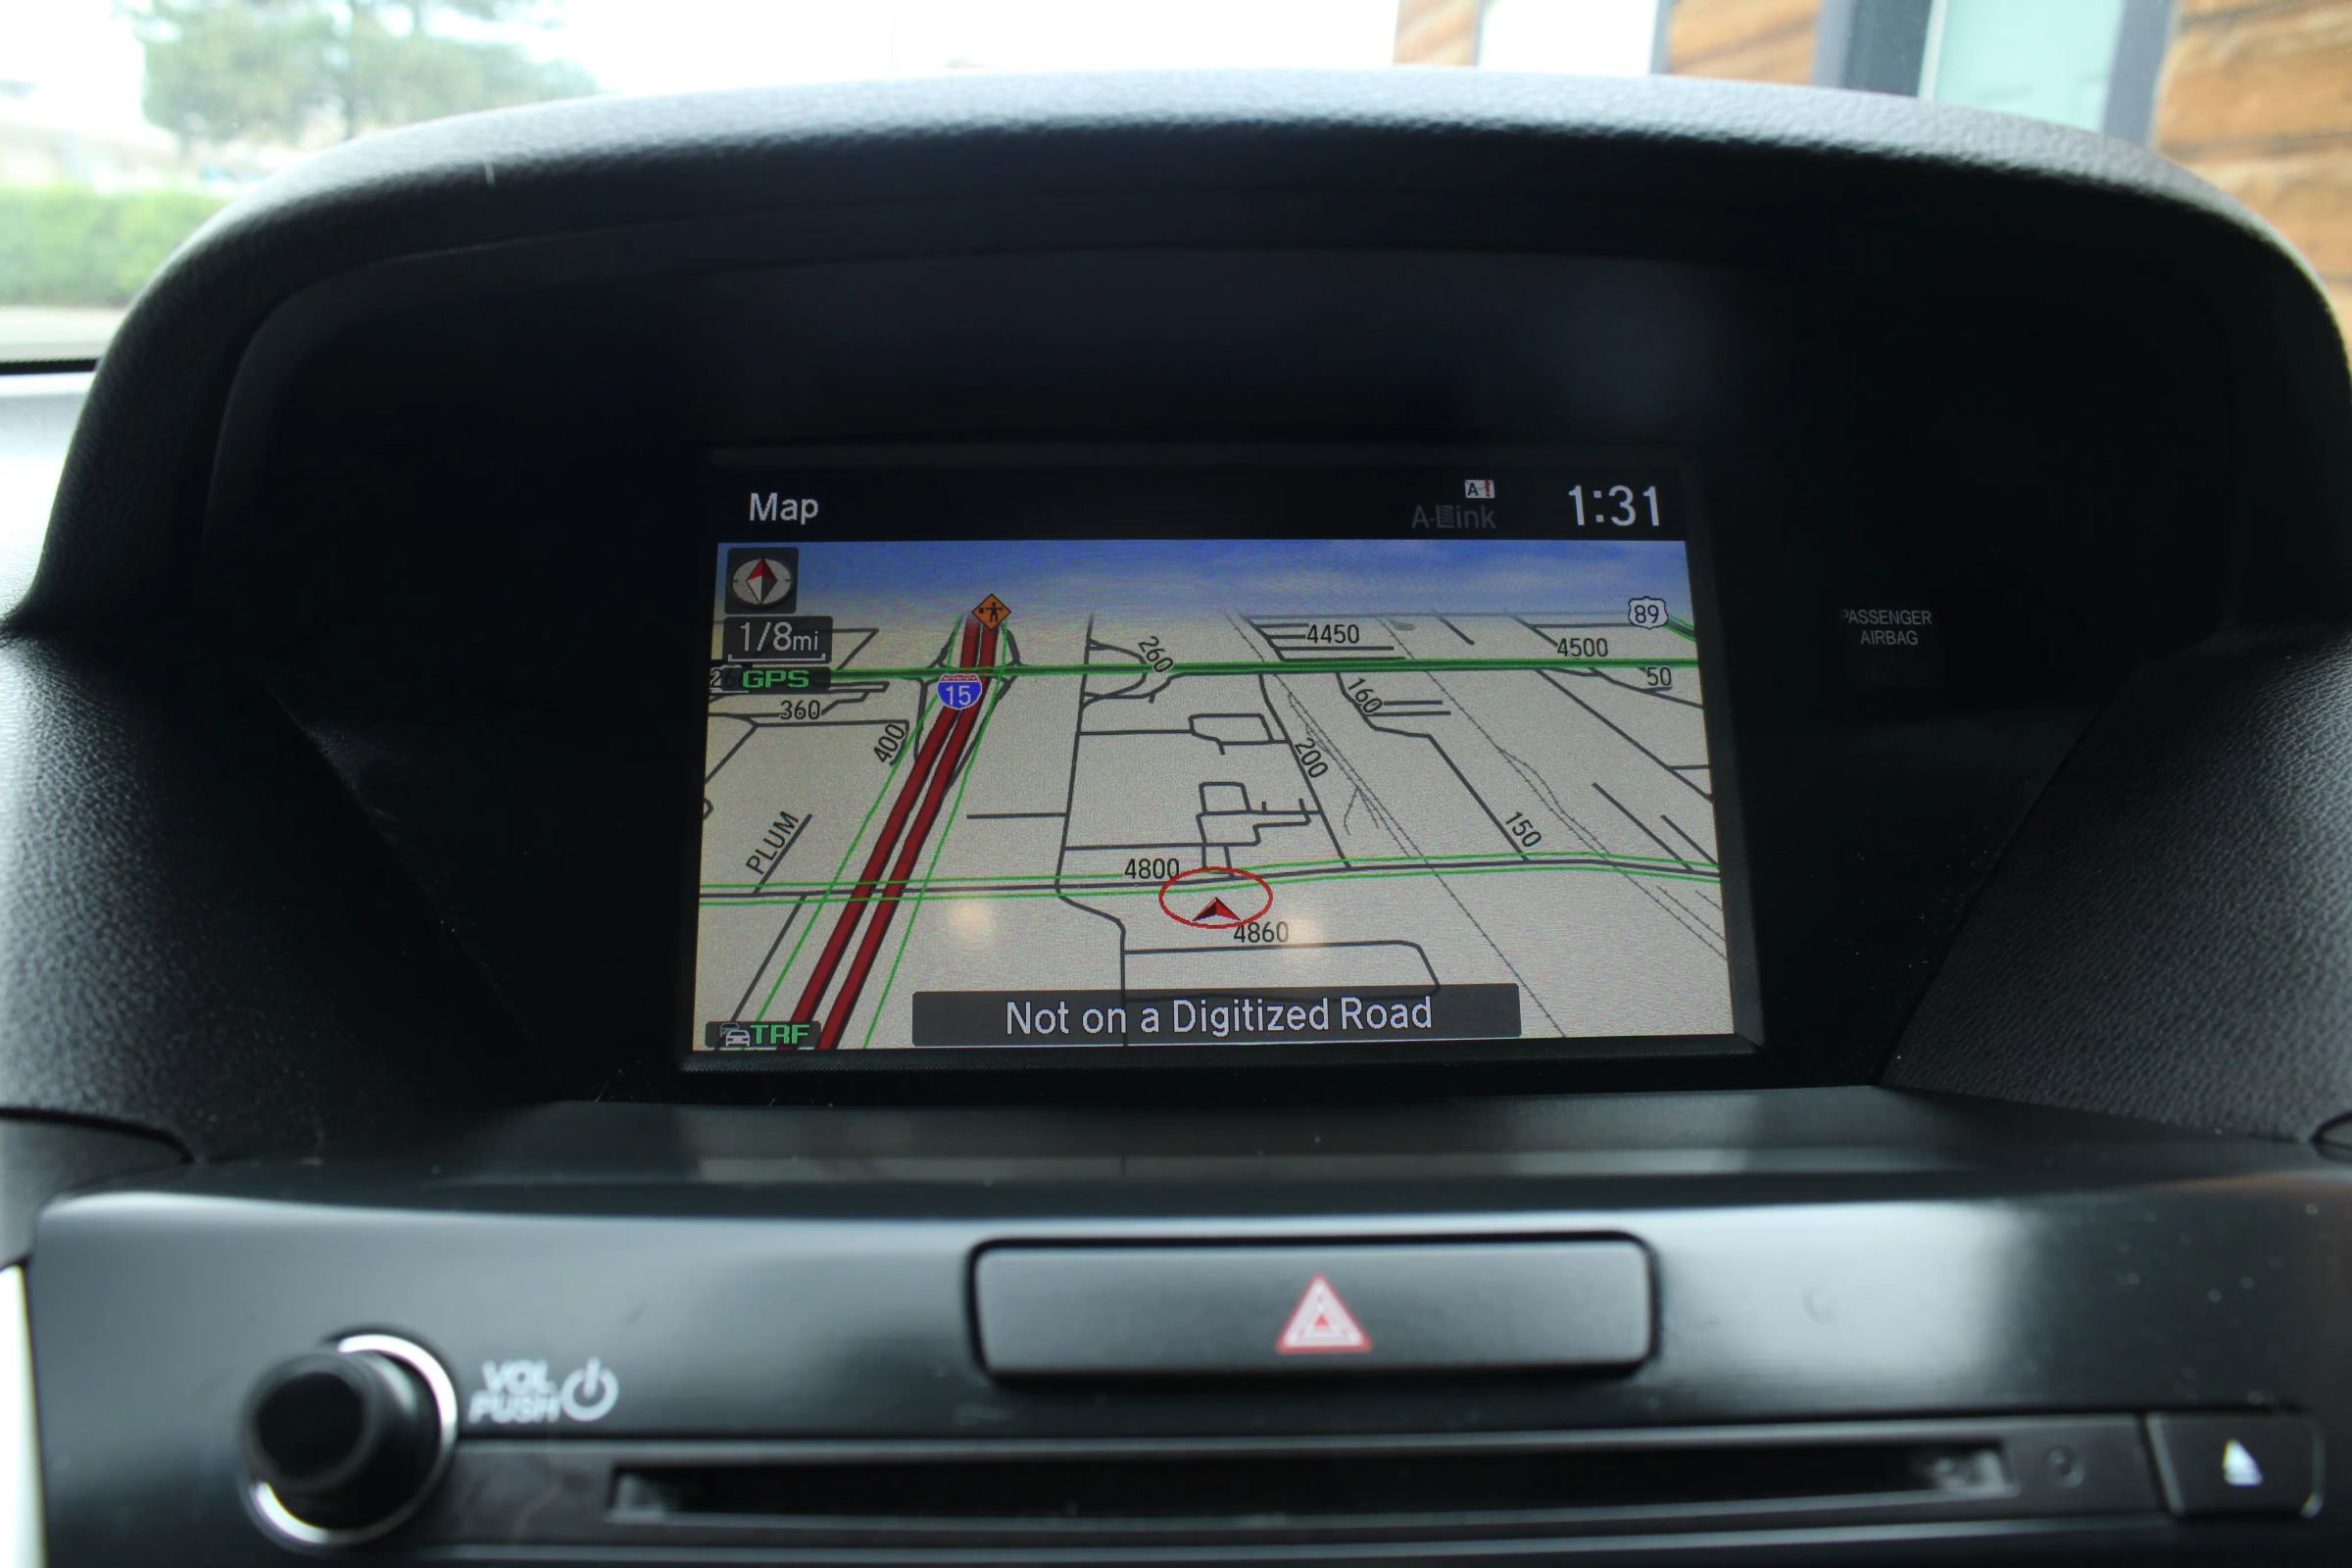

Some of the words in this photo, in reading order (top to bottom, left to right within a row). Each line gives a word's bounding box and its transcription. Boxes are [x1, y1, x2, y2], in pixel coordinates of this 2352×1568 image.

[749, 492, 819, 525] Map
[1411, 504, 1497, 529] A-Link
[1568, 484, 1661, 526] 1:31
[1634, 604, 1659, 624] 89
[1841, 609, 1933, 625] PASSENGER
[1305, 623, 1360, 645] 4450
[1860, 629, 1919, 646] AIRBAG
[1137, 635, 1174, 674] 260
[1556, 637, 1609, 659] 4500
[742, 669, 810, 689] GPS
[1646, 665, 1672, 687] 50
[945, 685, 972, 708] 15
[1348, 676, 1384, 714] 160
[780, 699, 821, 720] 360
[873, 722, 906, 764] 400
[1294, 737, 1329, 780] 200
[1503, 810, 1543, 850] 150
[745, 809, 801, 876] PLUM
[1123, 857, 1181, 879] 4800
[1233, 921, 1291, 944] 4860
[1006, 1000, 1070, 1035] Not
[1082, 1006, 1127, 1034] on
[1140, 1005, 1160, 1034] a
[1173, 997, 1329, 1038] Digitized
[1340, 995, 1433, 1030] Road
[750, 1023, 811, 1045] TRF
[481, 1358, 558, 1396] VOL
[467, 1390, 562, 1425] PUSH
